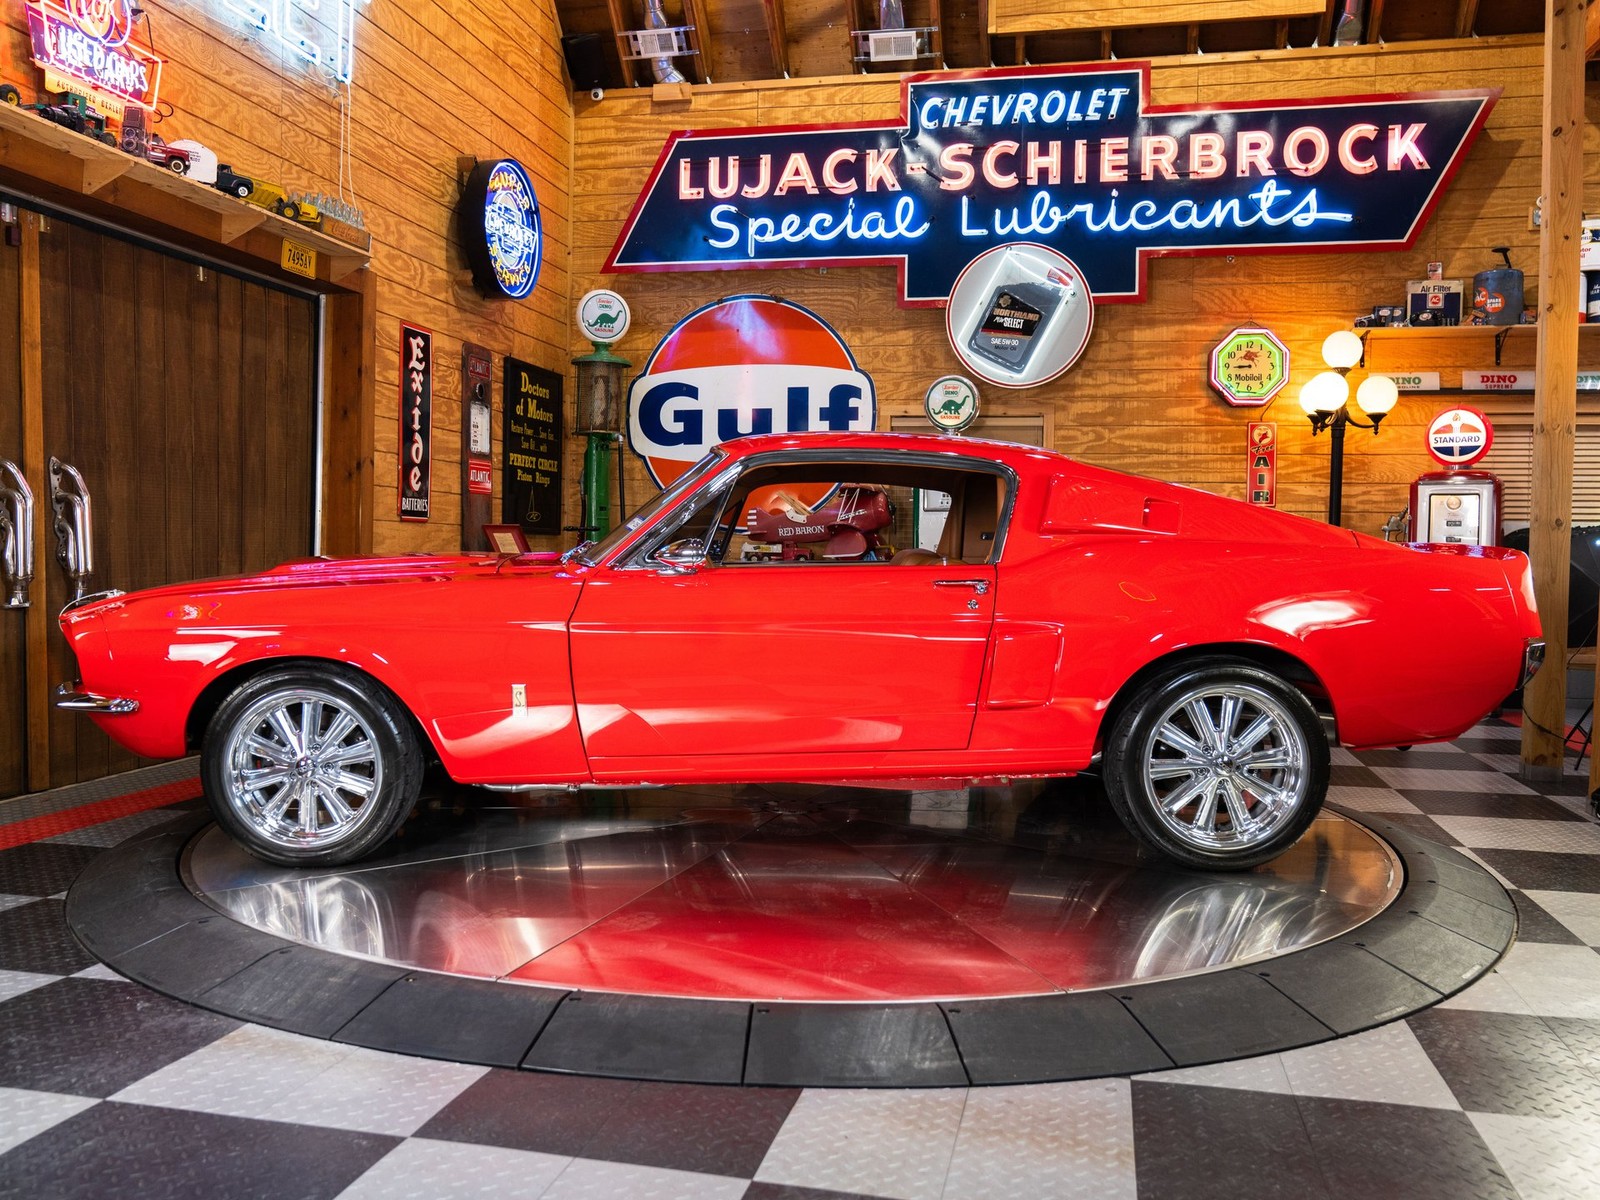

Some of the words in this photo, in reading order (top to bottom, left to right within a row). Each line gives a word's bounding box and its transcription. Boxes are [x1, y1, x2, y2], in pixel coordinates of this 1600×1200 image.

[920, 88, 1130, 129] CHEVROLET
[706, 196, 930, 257] Special
[962, 179, 1352, 236] Lubricants
[1433, 284, 1451, 292] Filter
[993, 308, 1040, 321] NORTHLAND
[1246, 341, 1254, 349] 12
[1227, 351, 1236, 359] 10
[1267, 350, 1272, 359] 2
[1269, 362, 1275, 371] 3
[1227, 374, 1232, 382] 8
[1481, 375, 1517, 383] DINO
[521, 371, 550, 399] Doctors
[1246, 384, 1252, 393] 6
[1259, 381, 1264, 389] 5
[408, 336, 425, 493] Exide
[516, 398, 524, 416] of
[527, 397, 553, 423] Motors
[638, 381, 862, 447] Gulf
[1434, 436, 1480, 444] STANDARD
[1250, 444, 1275, 455] Free
[509, 452, 536, 469] PERFECT
[538, 458, 558, 472] CIRCLE
[470, 469, 490, 484] ATLANTIC
[517, 469, 532, 482] Piston
[1252, 455, 1271, 503] AIR
[402, 497, 428, 513] BATTERIES
[778, 527, 794, 536] RED
[796, 525, 825, 535] BARON
